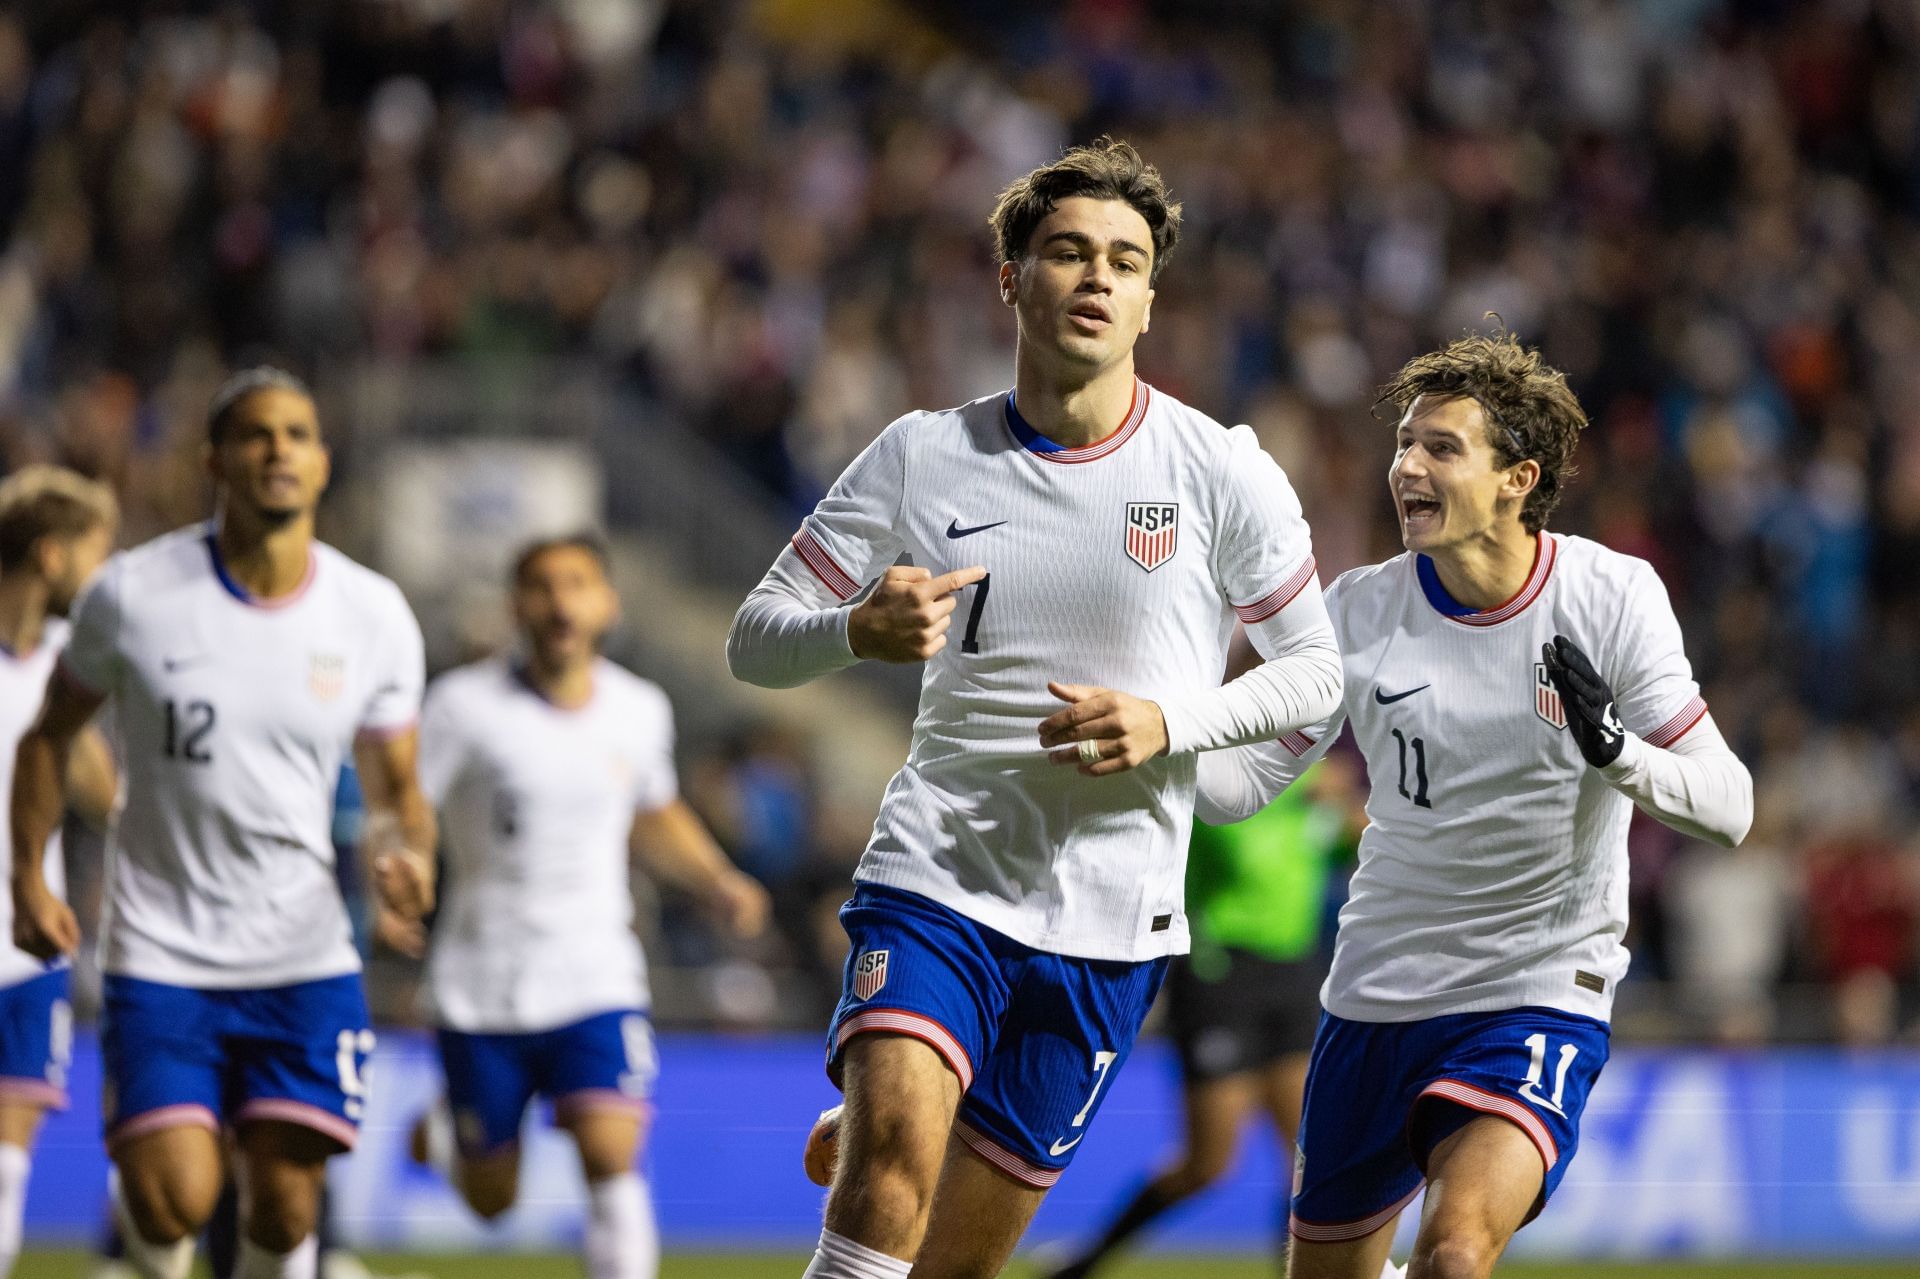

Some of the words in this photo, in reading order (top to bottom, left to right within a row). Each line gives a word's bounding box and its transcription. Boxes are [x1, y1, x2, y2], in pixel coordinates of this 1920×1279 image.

[1130, 507, 1174, 531] USA
[952, 572, 991, 655] 7
[164, 697, 216, 764] 12
[1391, 727, 1433, 809] 11
[858, 952, 886, 973] USA
[1071, 1051, 1118, 1127] 7
[1521, 1033, 1579, 1110] 11
